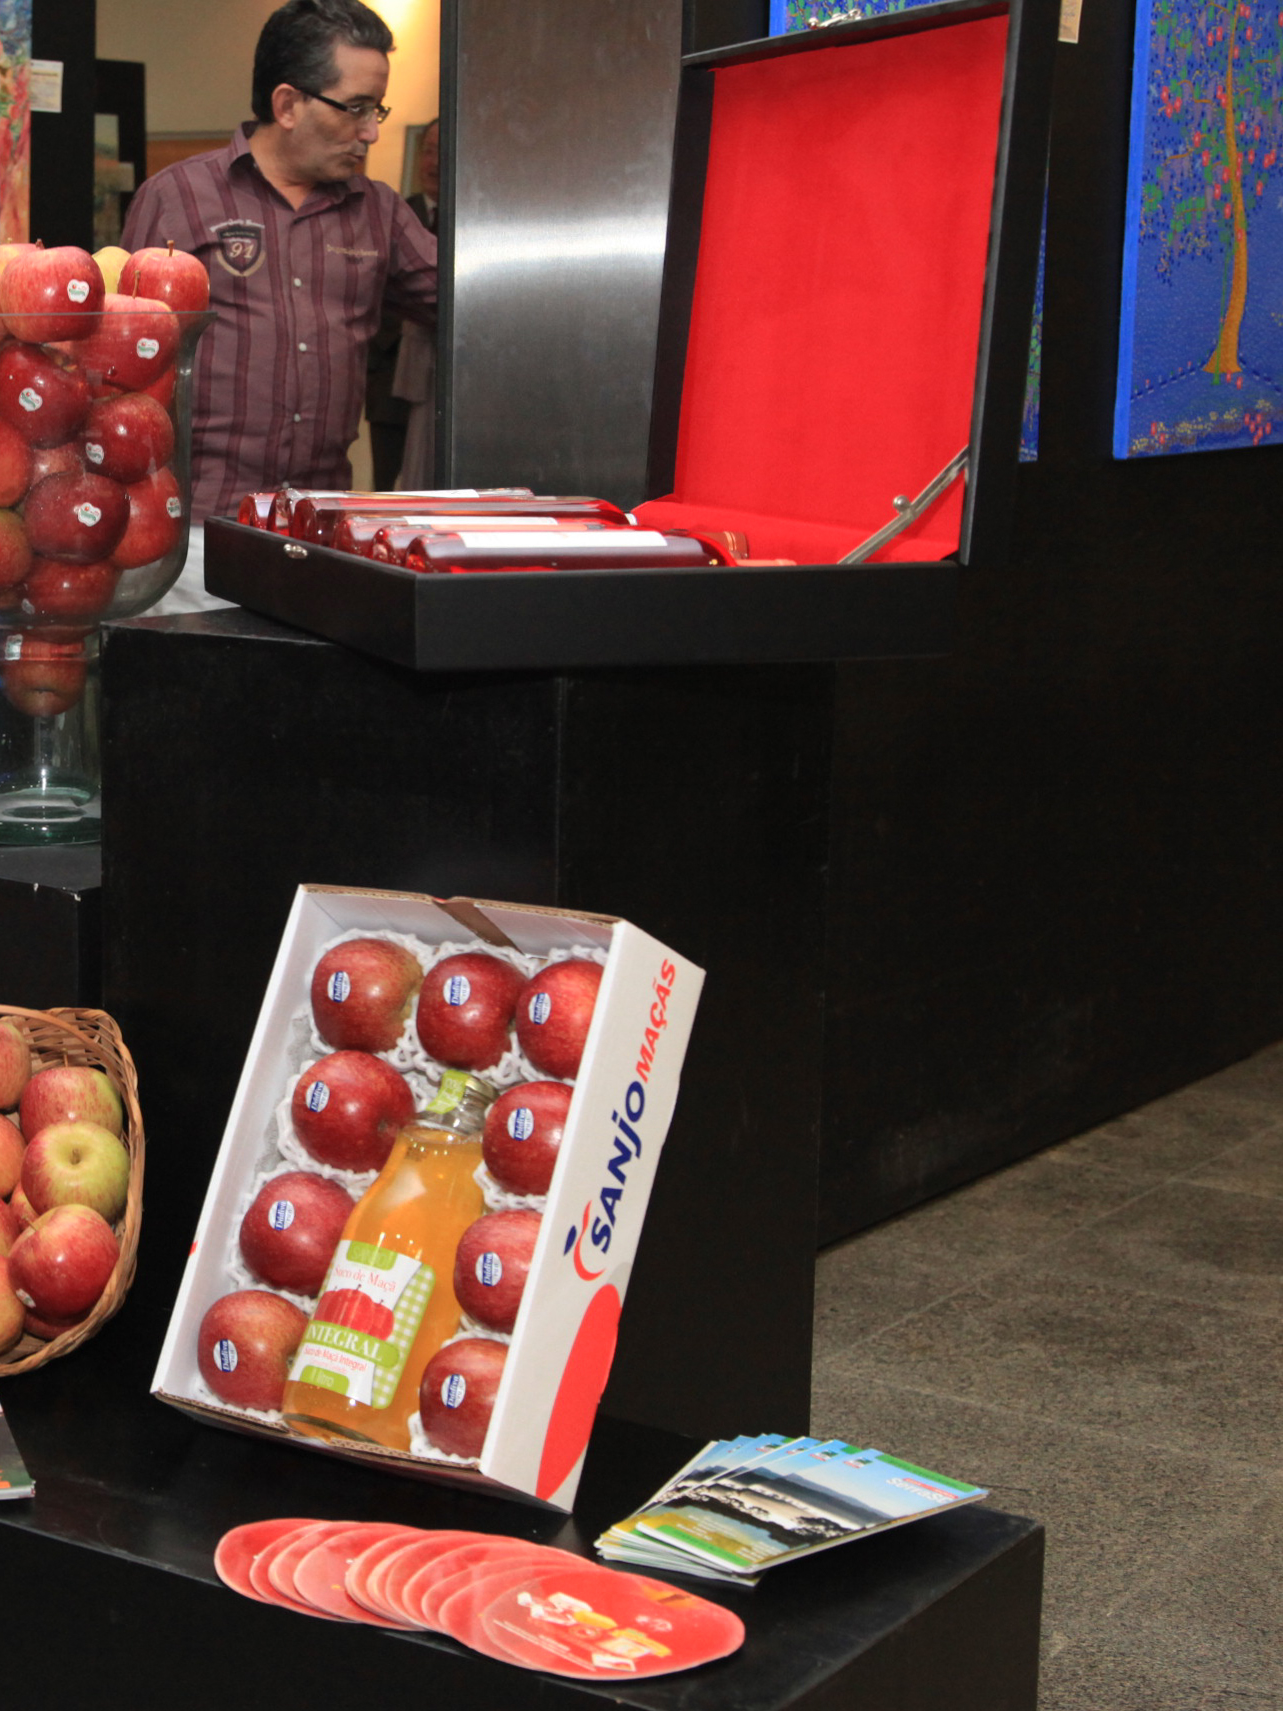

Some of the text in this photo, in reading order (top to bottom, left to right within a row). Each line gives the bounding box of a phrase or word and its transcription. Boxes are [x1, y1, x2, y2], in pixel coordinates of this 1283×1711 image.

[635, 958, 676, 1084] MAÇÃS
[352, 1269, 365, 1282] de
[367, 1271, 397, 1294] Maçã
[339, 1354, 367, 1371] Integral
